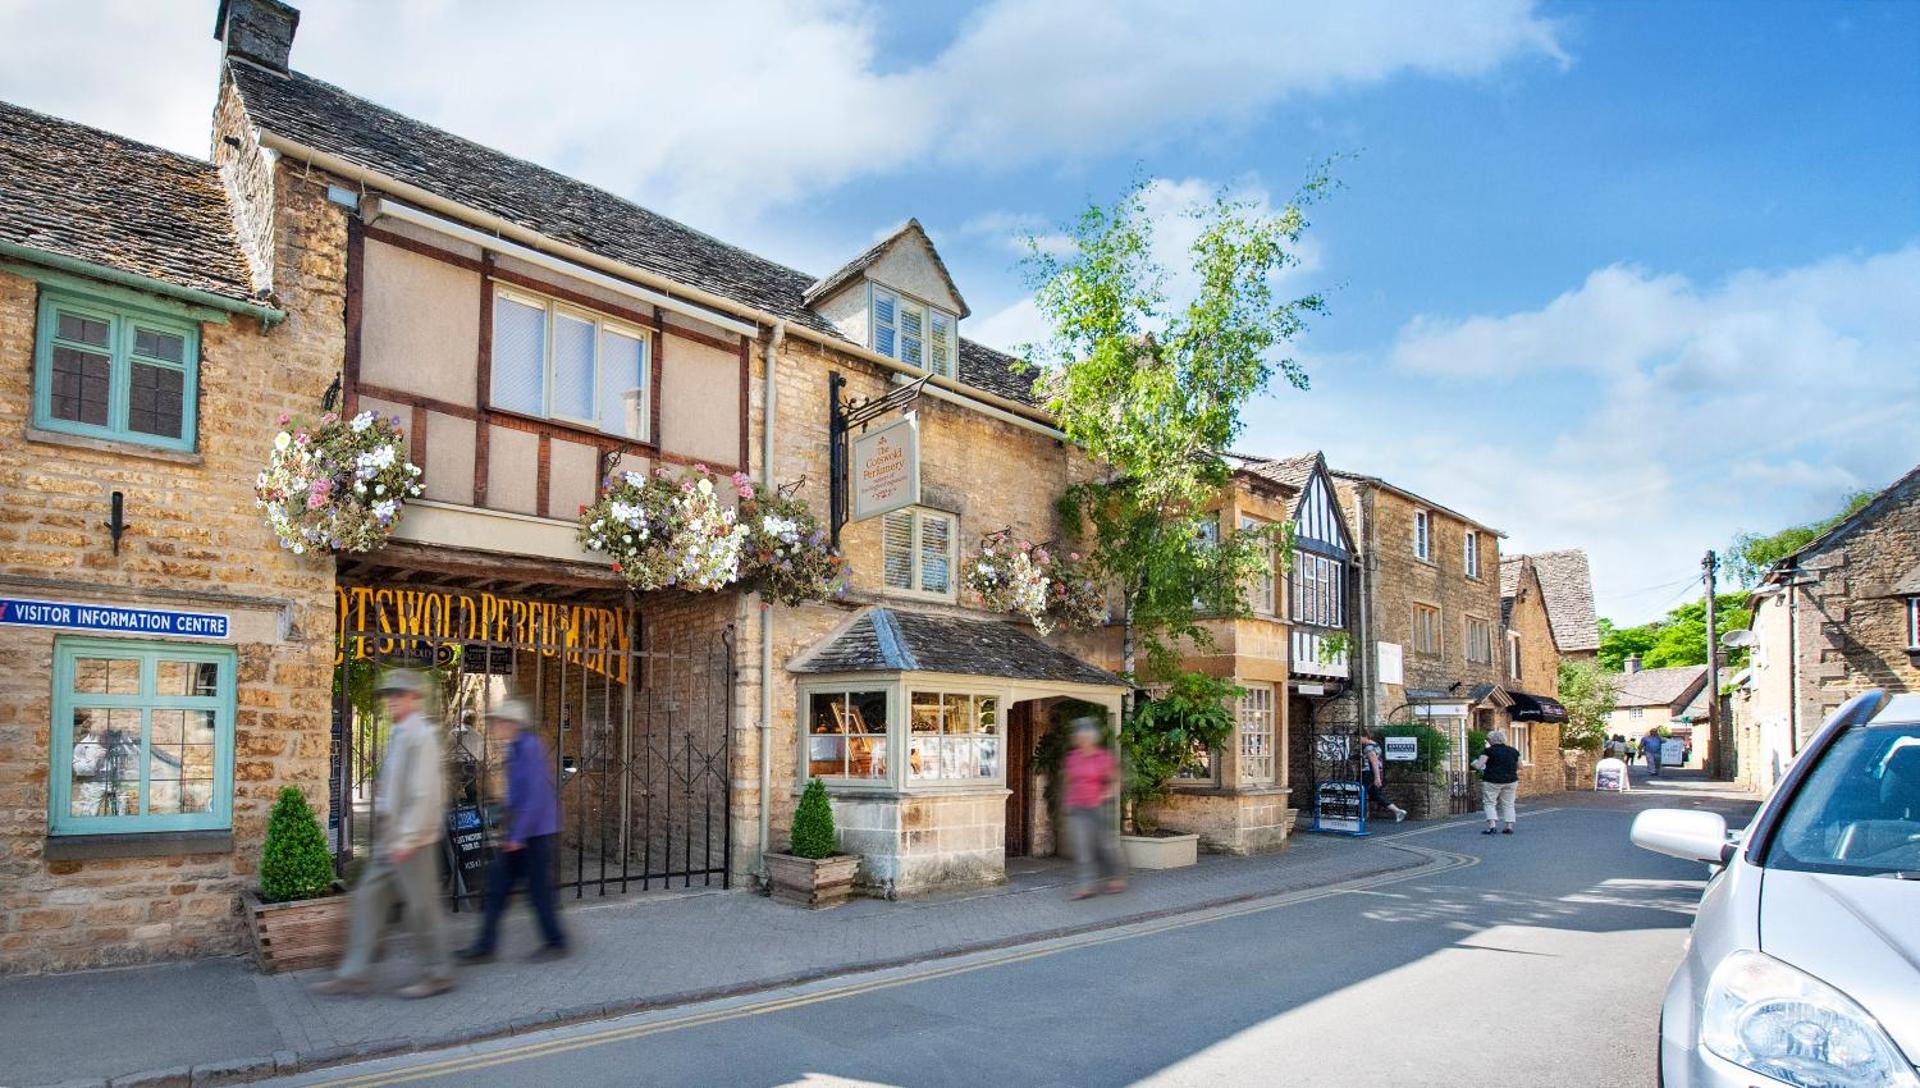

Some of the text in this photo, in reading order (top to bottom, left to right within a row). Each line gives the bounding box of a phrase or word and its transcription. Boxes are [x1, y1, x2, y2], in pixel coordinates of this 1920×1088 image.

[15, 604, 71, 623] VISITOR
[77, 608, 171, 630] INFORMATION
[176, 616, 225, 633] CENTRE
[481, 592, 630, 686] PERFUMERY
